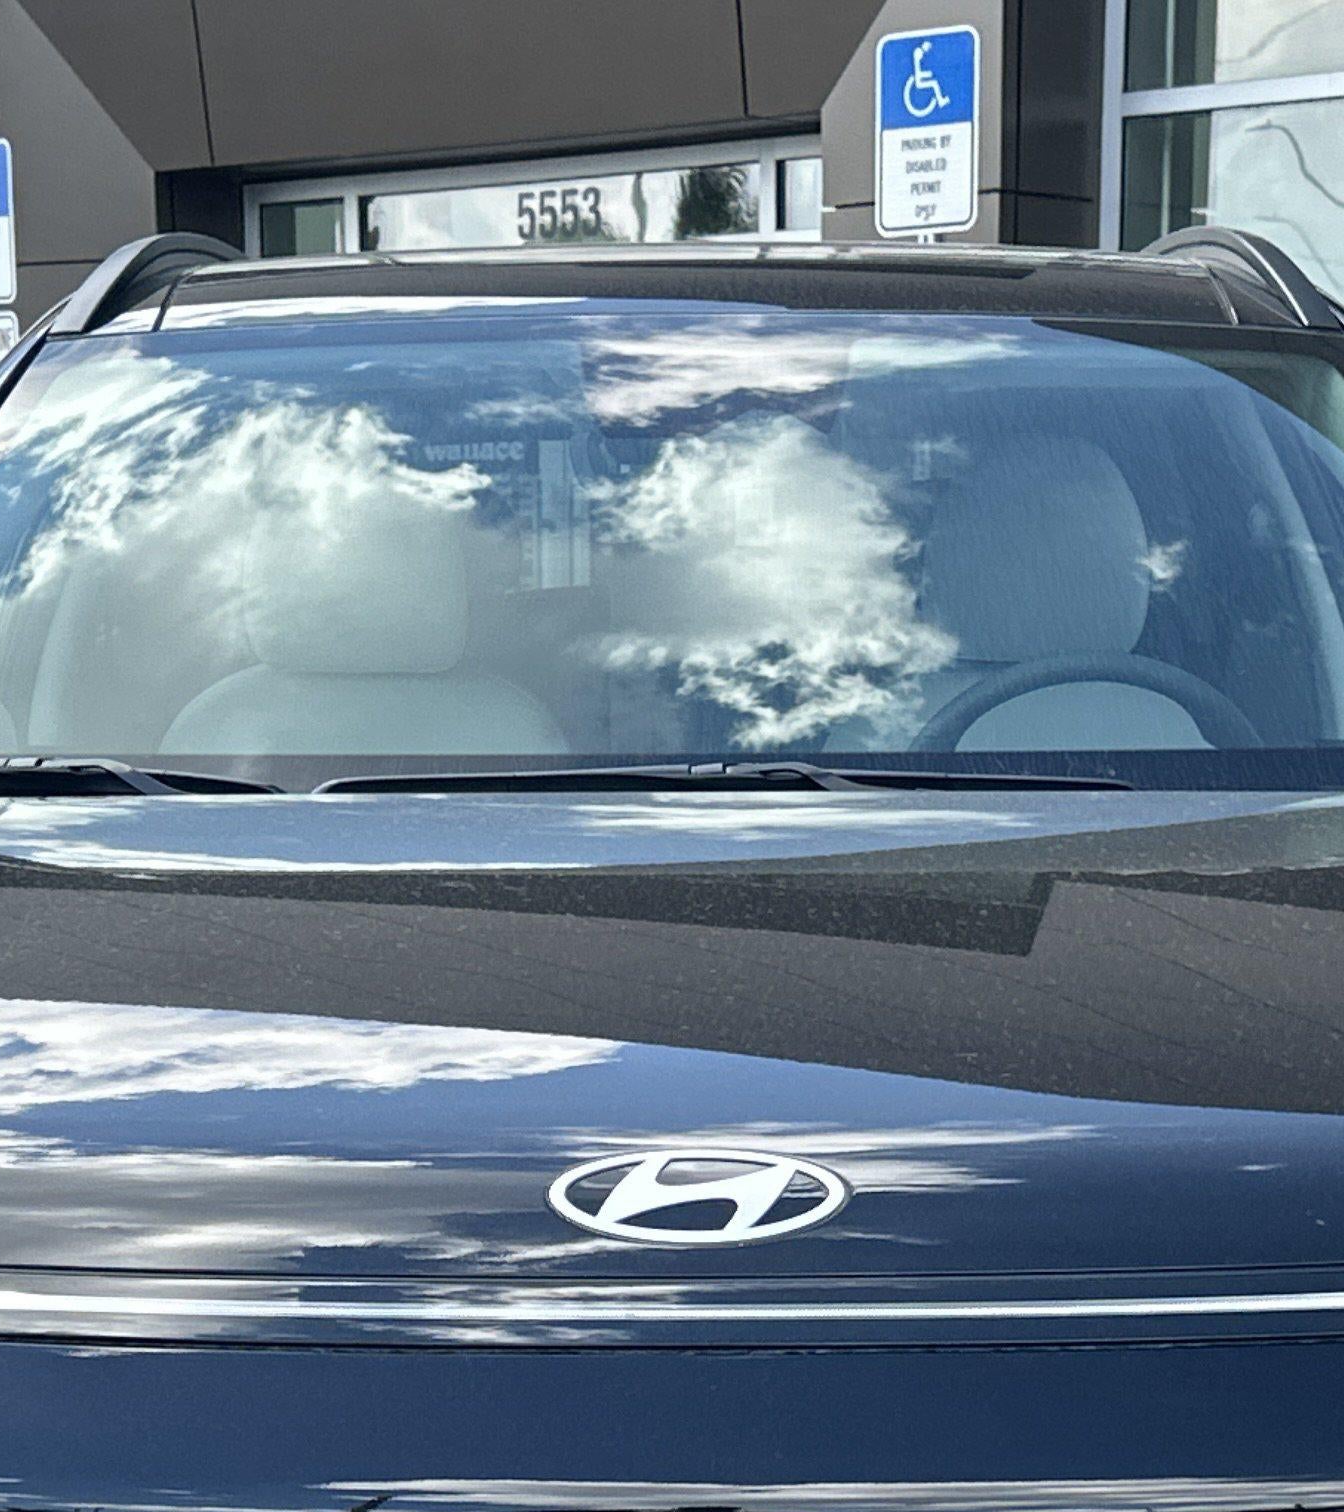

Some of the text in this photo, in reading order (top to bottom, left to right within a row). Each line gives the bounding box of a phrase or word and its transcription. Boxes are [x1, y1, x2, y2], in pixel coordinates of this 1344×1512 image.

[901, 135, 951, 152] PARKING BY
[905, 157, 948, 174] DISABLED
[910, 180, 942, 195] PERMIT
[517, 186, 602, 241] 5553
